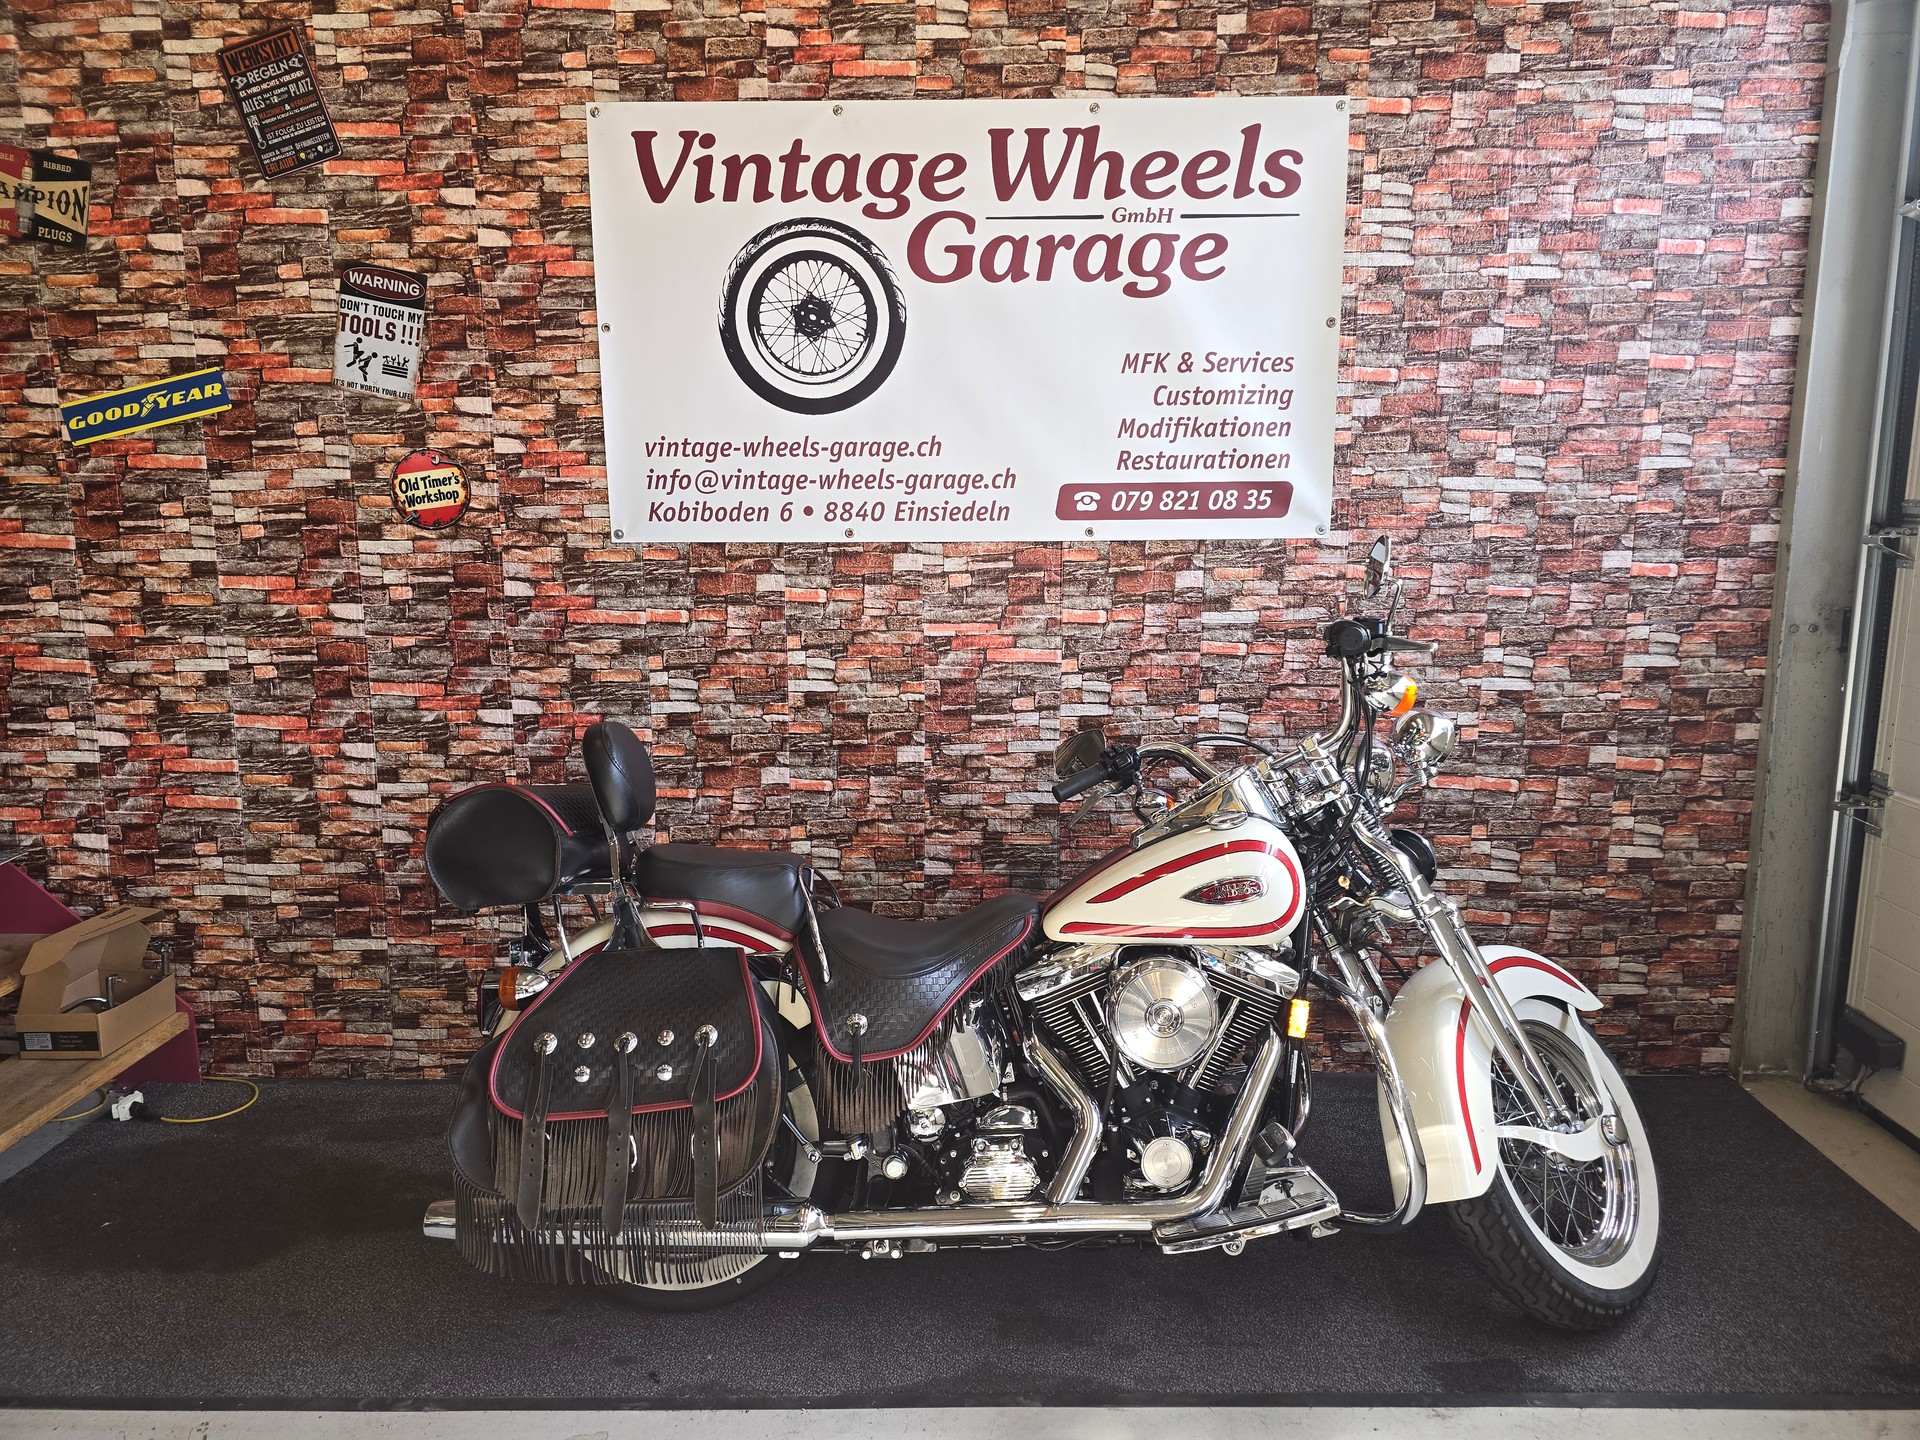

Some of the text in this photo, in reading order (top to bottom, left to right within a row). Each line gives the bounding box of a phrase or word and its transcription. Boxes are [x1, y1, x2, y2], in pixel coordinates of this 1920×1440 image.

[225, 33, 295, 73] WERKSTATT
[246, 59, 289, 83] REGELN
[240, 95, 265, 113] ALLES
[288, 77, 313, 96] PLATZ
[284, 102, 291, 110] &
[265, 132, 274, 140] IST
[275, 125, 295, 136] FOLGE
[303, 114, 324, 126] LEISTEN
[43, 161, 71, 173] RIBBED
[631, 122, 1303, 220] Vintage Wheels
[1111, 206, 1174, 224] GmbH
[37, 226, 73, 243] PLUGS
[906, 210, 1229, 299] Garage
[349, 270, 420, 296] WARNING
[340, 298, 422, 324] DON'T TOUCH MY
[340, 312, 421, 347] TOOLS !!!
[1121, 350, 1295, 374] MFK & Services
[346, 381, 359, 389] NOT
[360, 384, 380, 393] WORTH
[381, 388, 397, 397] YOUR
[1153, 383, 1294, 411] Customizing
[1117, 415, 1292, 443] Modifikationen
[645, 435, 942, 463] vintage-wheels-garage.ch
[1116, 447, 1291, 471] Restaurationen
[398, 472, 460, 494] Old Timer's
[646, 467, 1017, 495] info@vintage-wheels-garage.ch
[405, 489, 459, 508] Workshop
[648, 500, 1010, 522] Kobiboden 6 8840 Einsiedeln
[1111, 489, 1273, 511] 079 821 08 35
